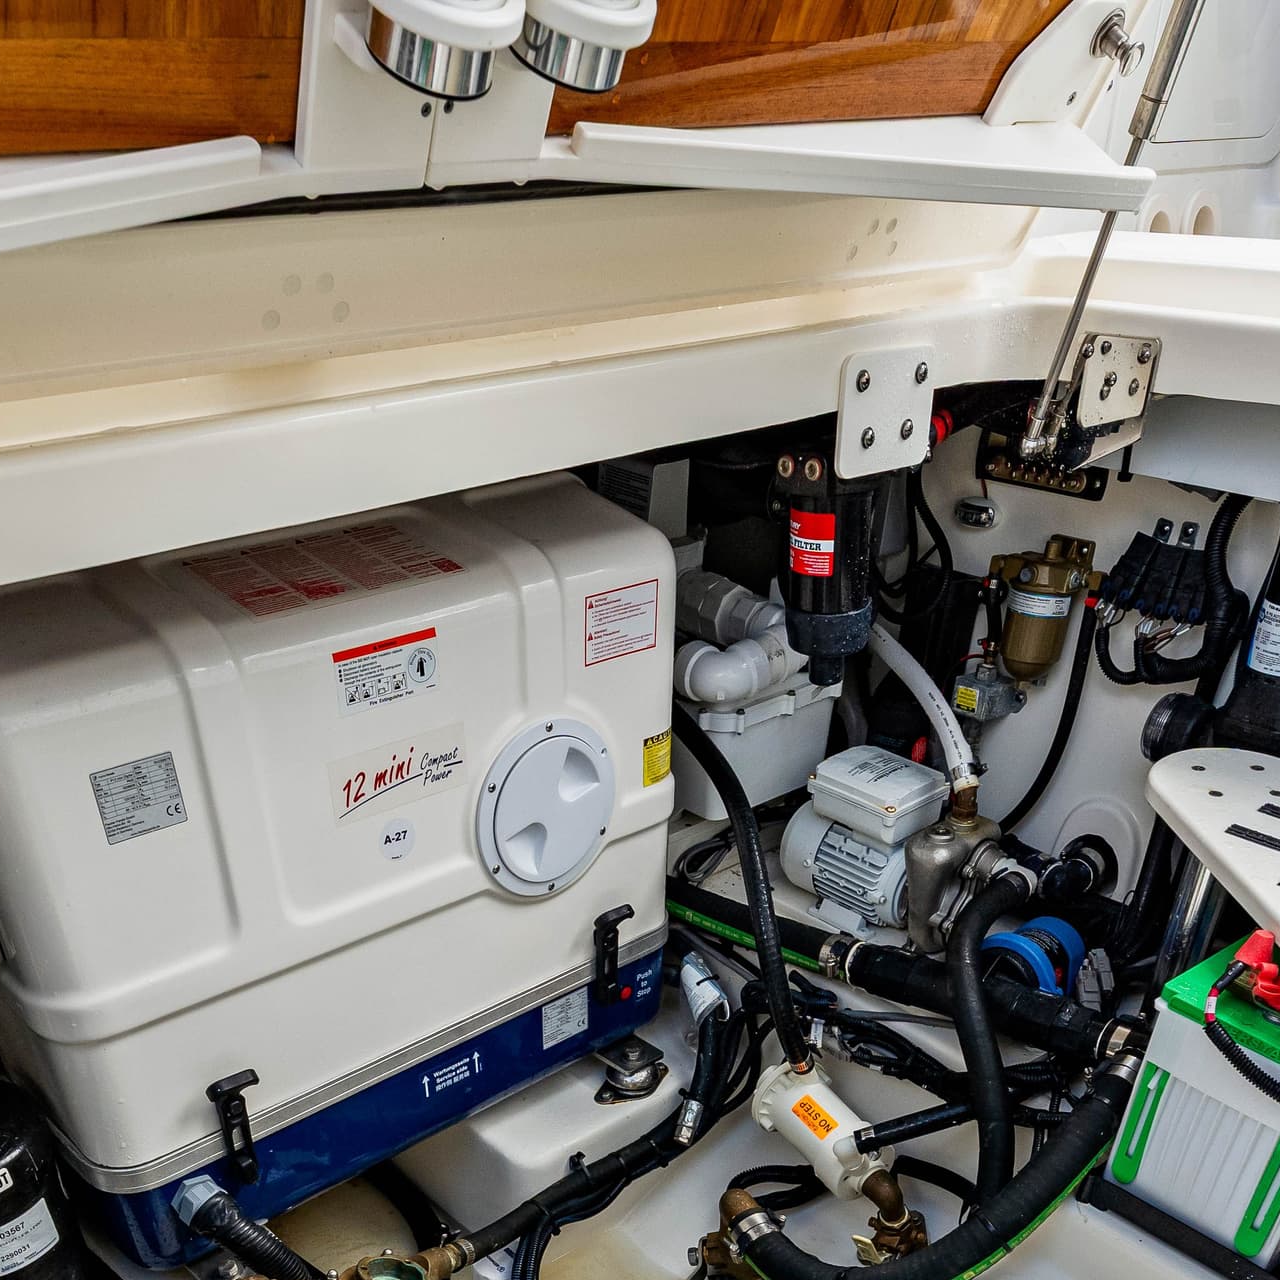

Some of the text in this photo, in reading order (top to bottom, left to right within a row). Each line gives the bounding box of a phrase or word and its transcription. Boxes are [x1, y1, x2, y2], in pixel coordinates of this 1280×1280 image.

[343, 746, 458, 808] 12 mini Compact
[424, 770, 452, 786] Power
[166, 803, 181, 816] CE
[384, 830, 408, 845] A-27
[636, 969, 653, 983] Push
[641, 980, 647, 988] to
[637, 987, 651, 999] Stop
[798, 1097, 834, 1134] NO STEP
